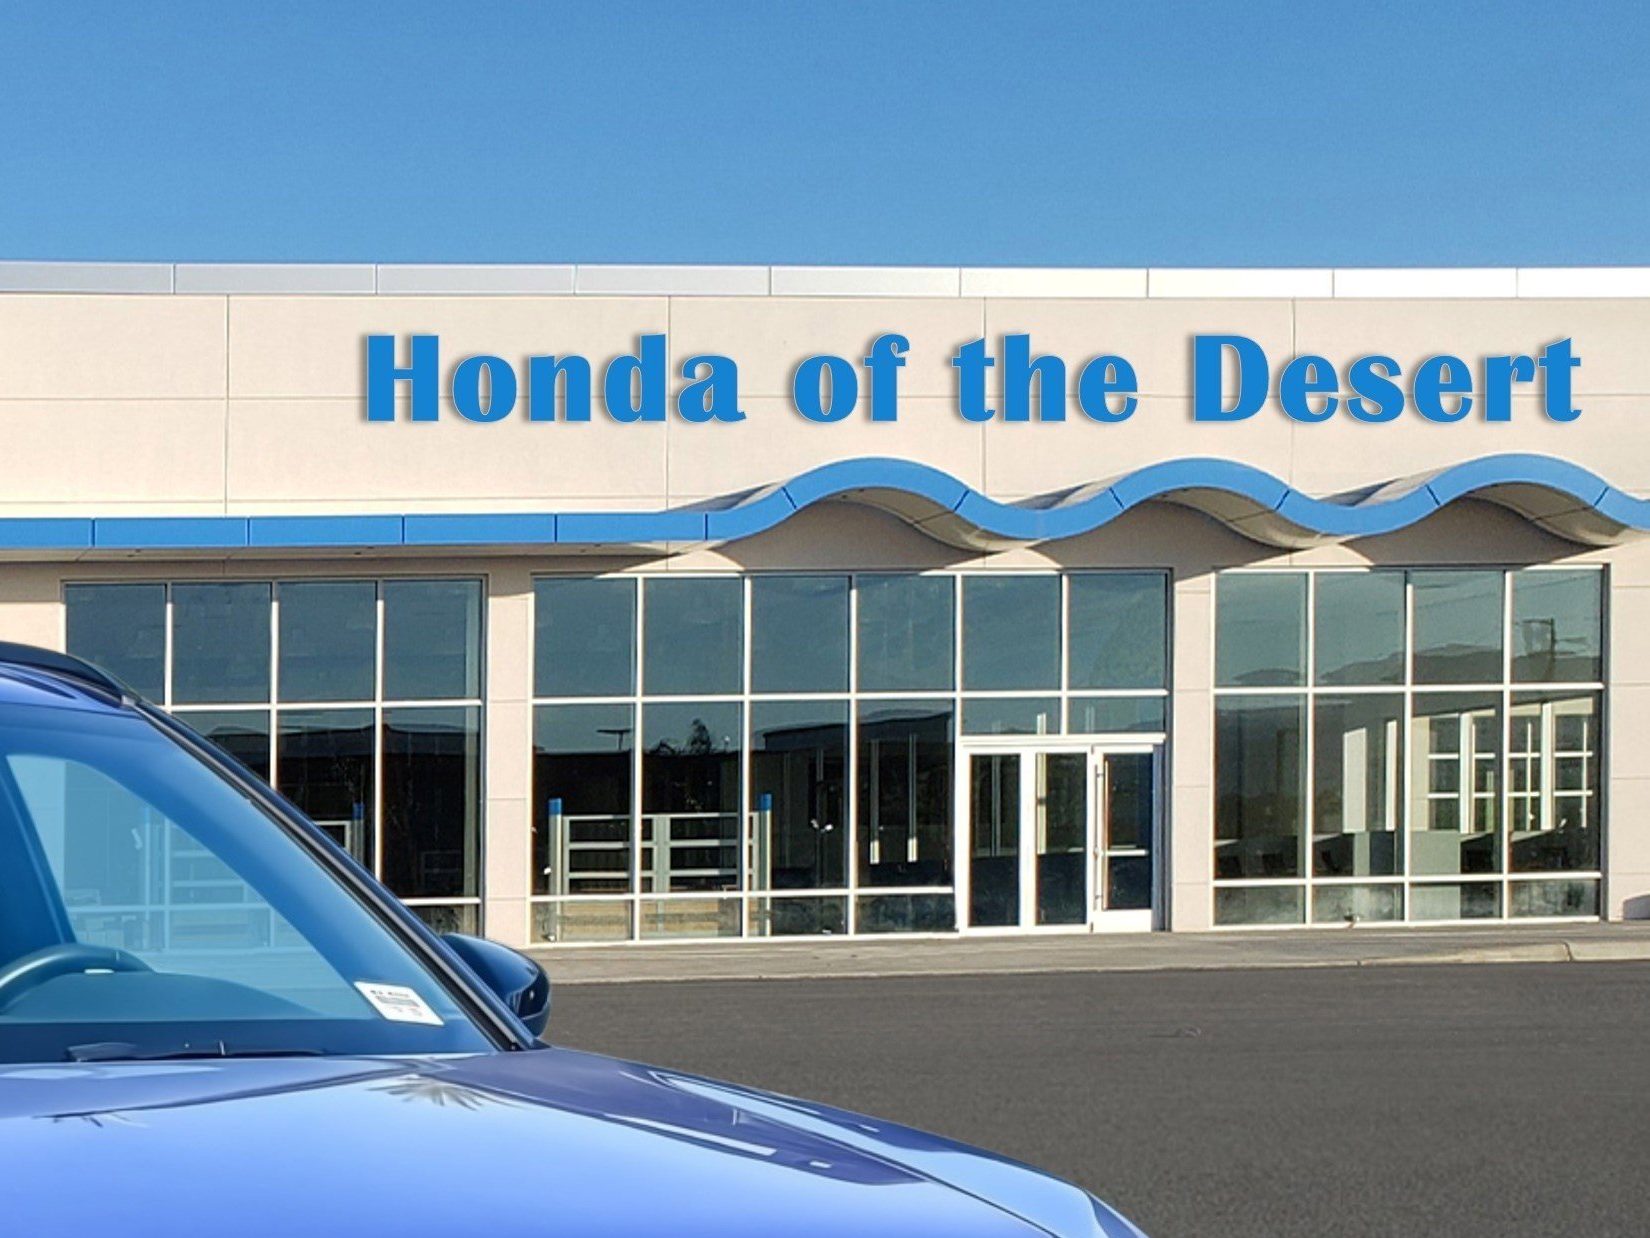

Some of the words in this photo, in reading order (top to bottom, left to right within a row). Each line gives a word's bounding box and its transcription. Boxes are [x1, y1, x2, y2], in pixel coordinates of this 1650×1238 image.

[366, 333, 746, 423] Honda
[793, 334, 910, 423] of
[952, 334, 1138, 423] the
[1193, 335, 1582, 423] Desert
